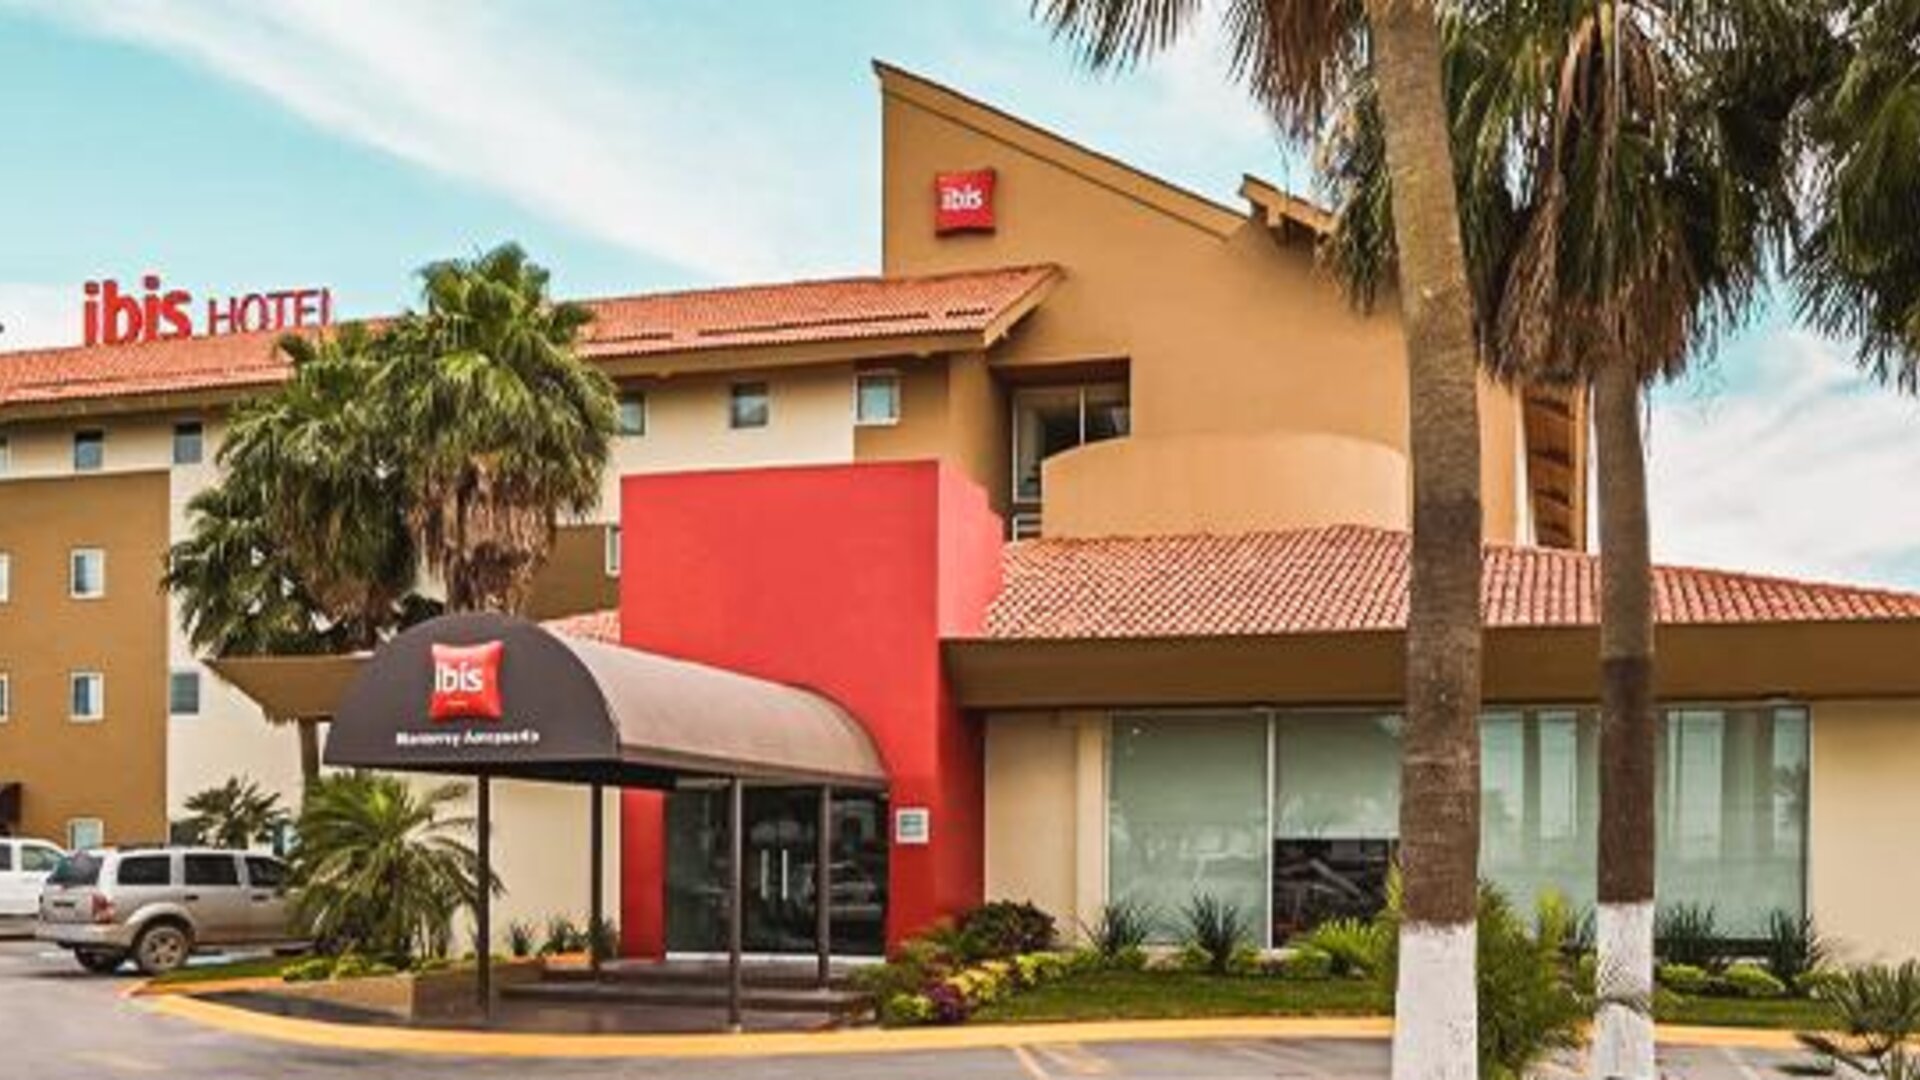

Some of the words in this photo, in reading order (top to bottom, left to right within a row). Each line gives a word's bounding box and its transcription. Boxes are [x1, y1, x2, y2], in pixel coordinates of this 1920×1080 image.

[940, 184, 983, 211] ibis
[84, 275, 192, 346] ibis
[435, 661, 483, 693] ibis
